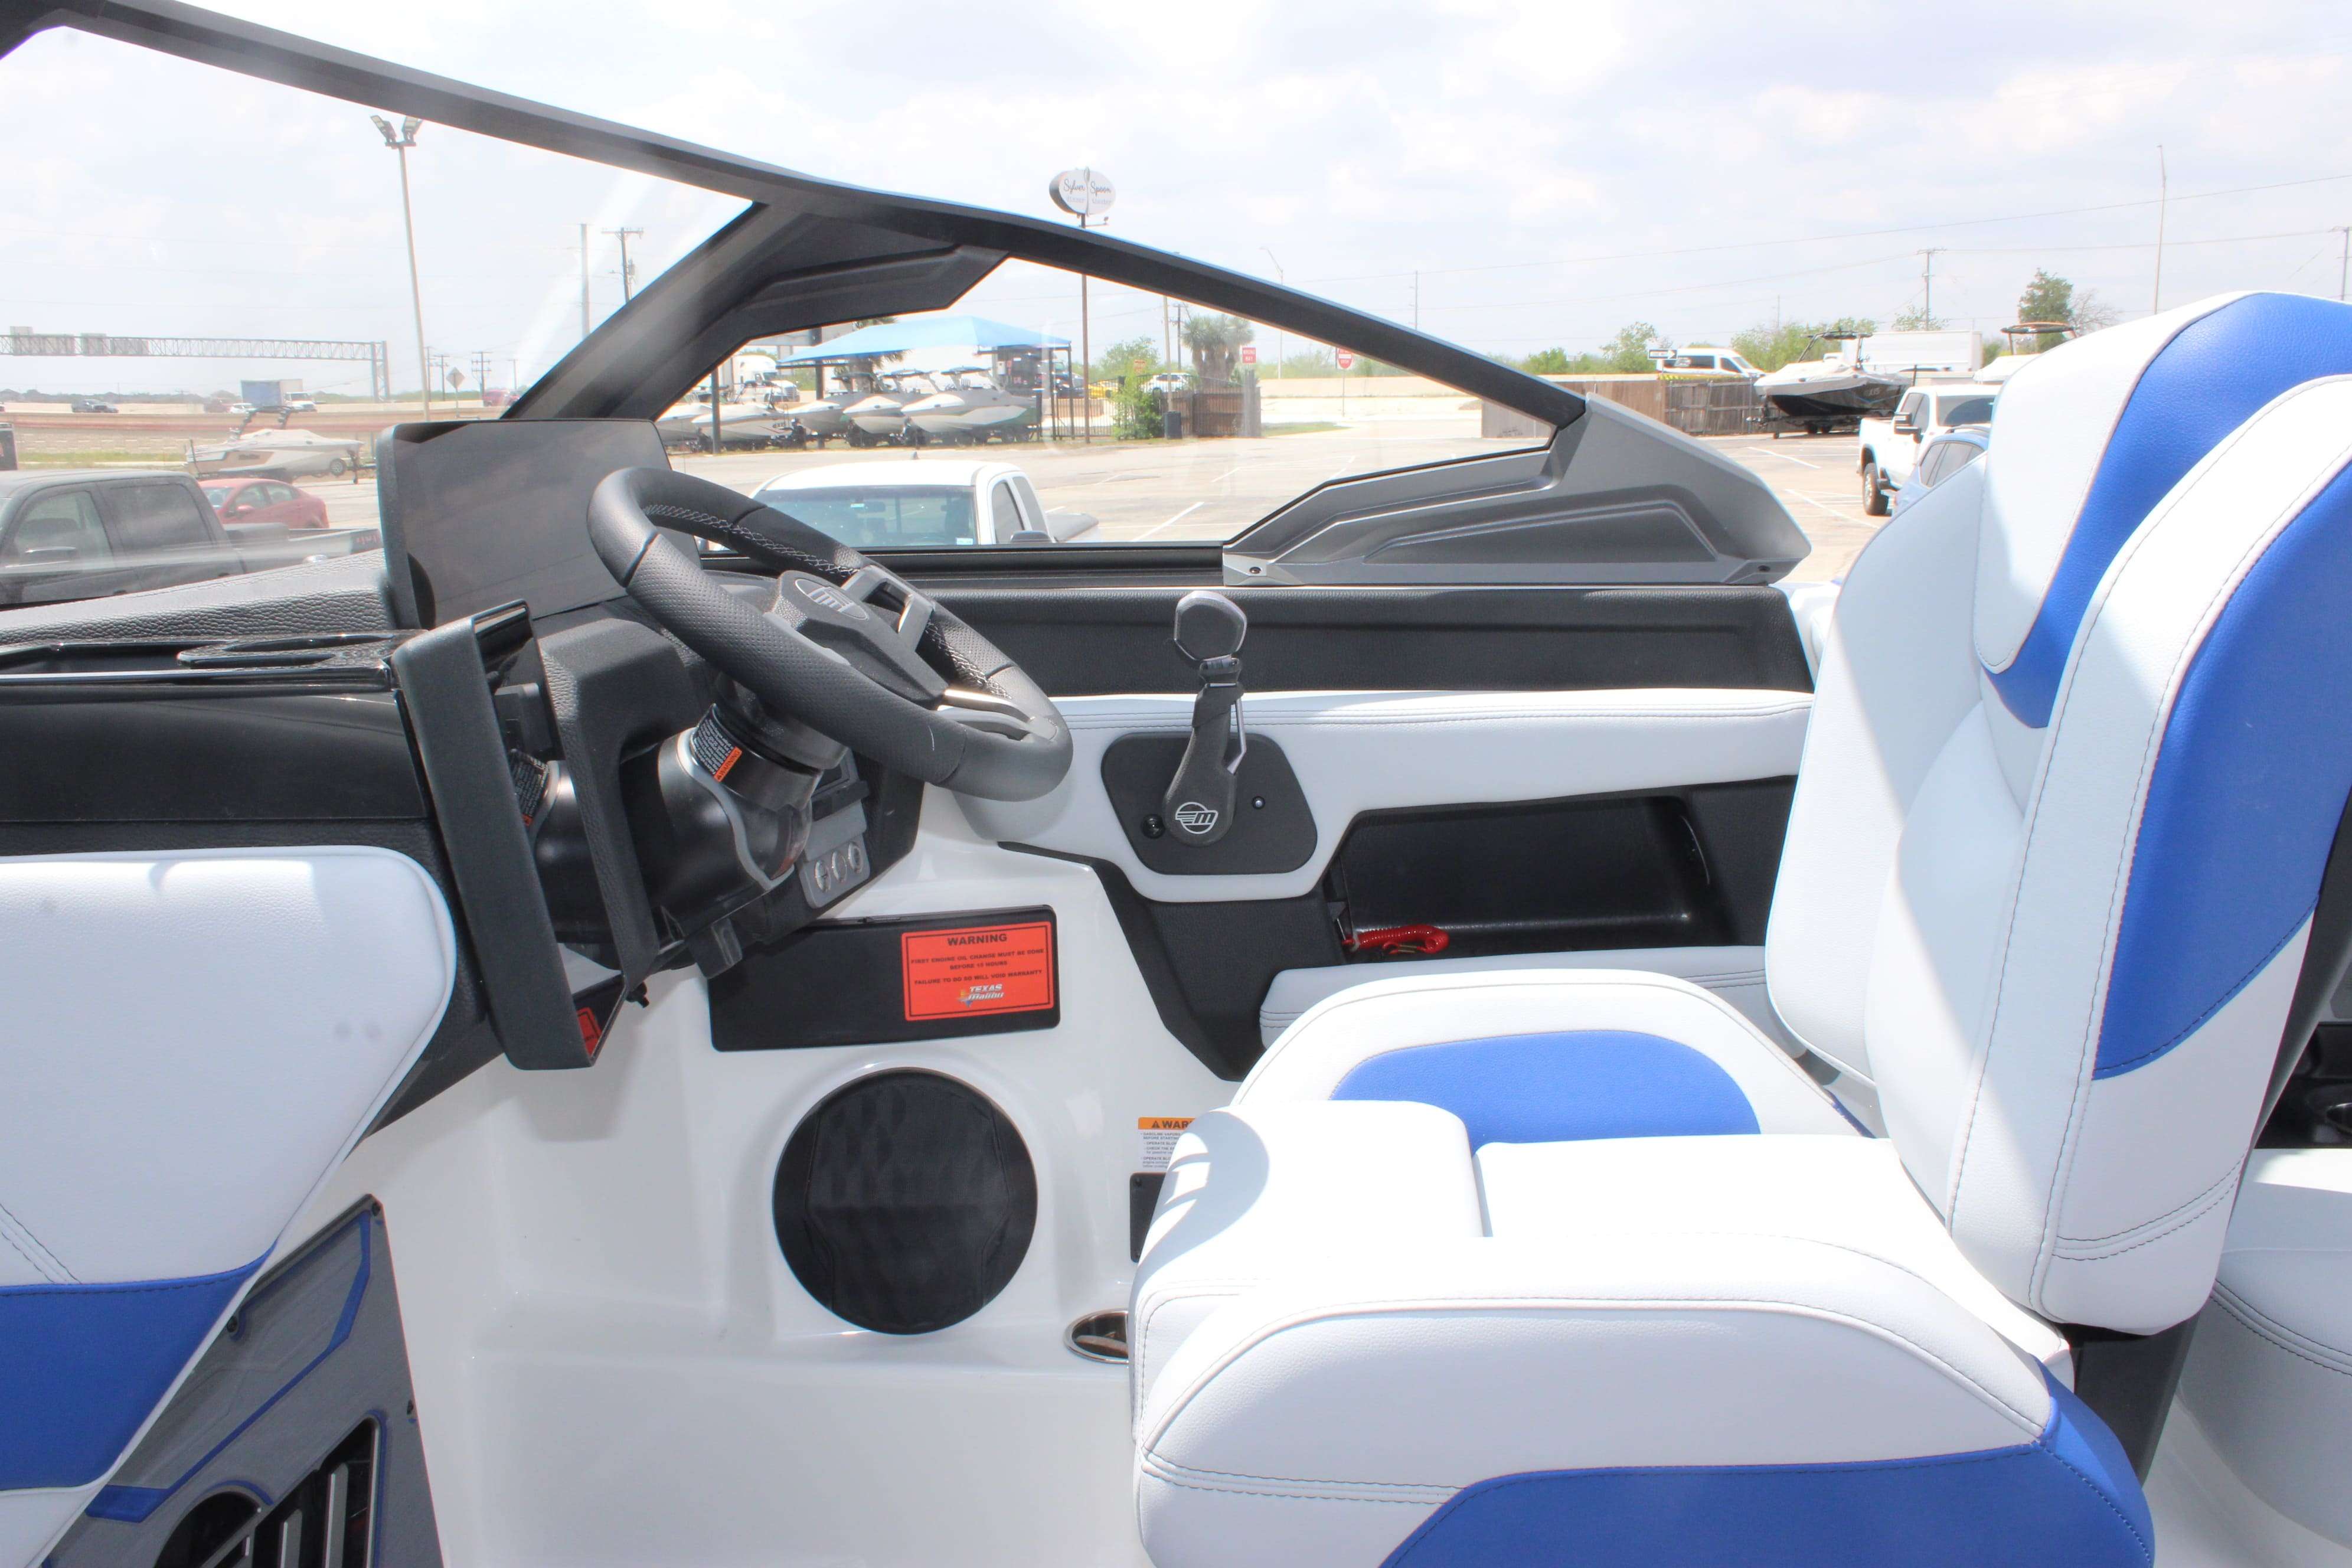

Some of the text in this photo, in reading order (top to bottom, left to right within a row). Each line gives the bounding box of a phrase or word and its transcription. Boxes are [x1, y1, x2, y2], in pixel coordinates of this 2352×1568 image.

[948, 933, 1007, 946] WARNING
[1008, 969, 1042, 978] WARRANTY
[969, 984, 1002, 992] TEXAS
[968, 992, 1004, 1001] Malibu
[1162, 1120, 1192, 1129] WAR
